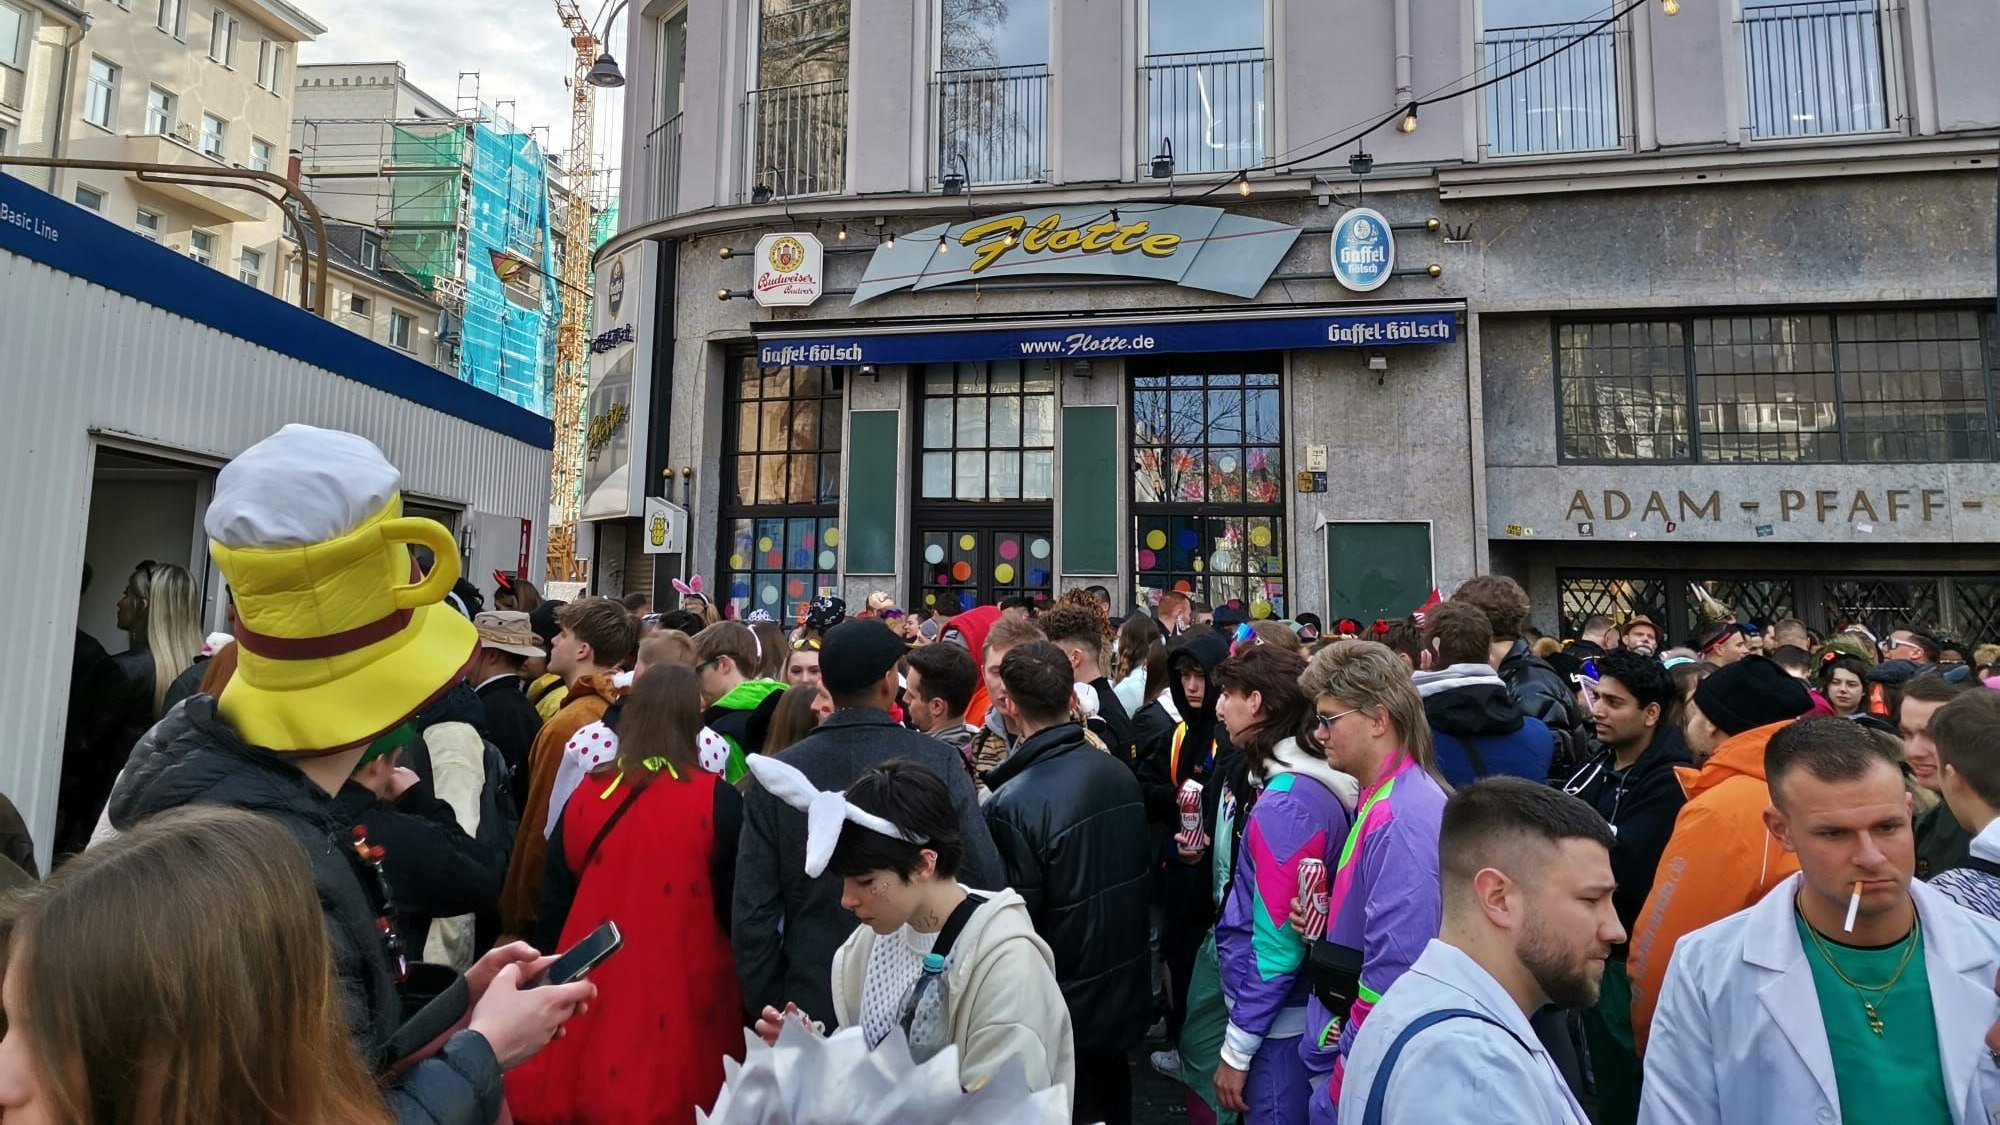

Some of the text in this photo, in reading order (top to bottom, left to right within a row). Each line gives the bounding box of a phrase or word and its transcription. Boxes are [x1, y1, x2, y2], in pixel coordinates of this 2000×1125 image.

[0, 202, 59, 242] Basic Line
[958, 213, 1182, 273] Flotte
[1340, 245, 1386, 264] Gaffel
[757, 272, 816, 291] Budweiser
[1328, 319, 1450, 344] Gaffel-Kölsch
[762, 342, 863, 366] Gaffel-Kölsch
[1020, 332, 1156, 356] www.Flotte.de
